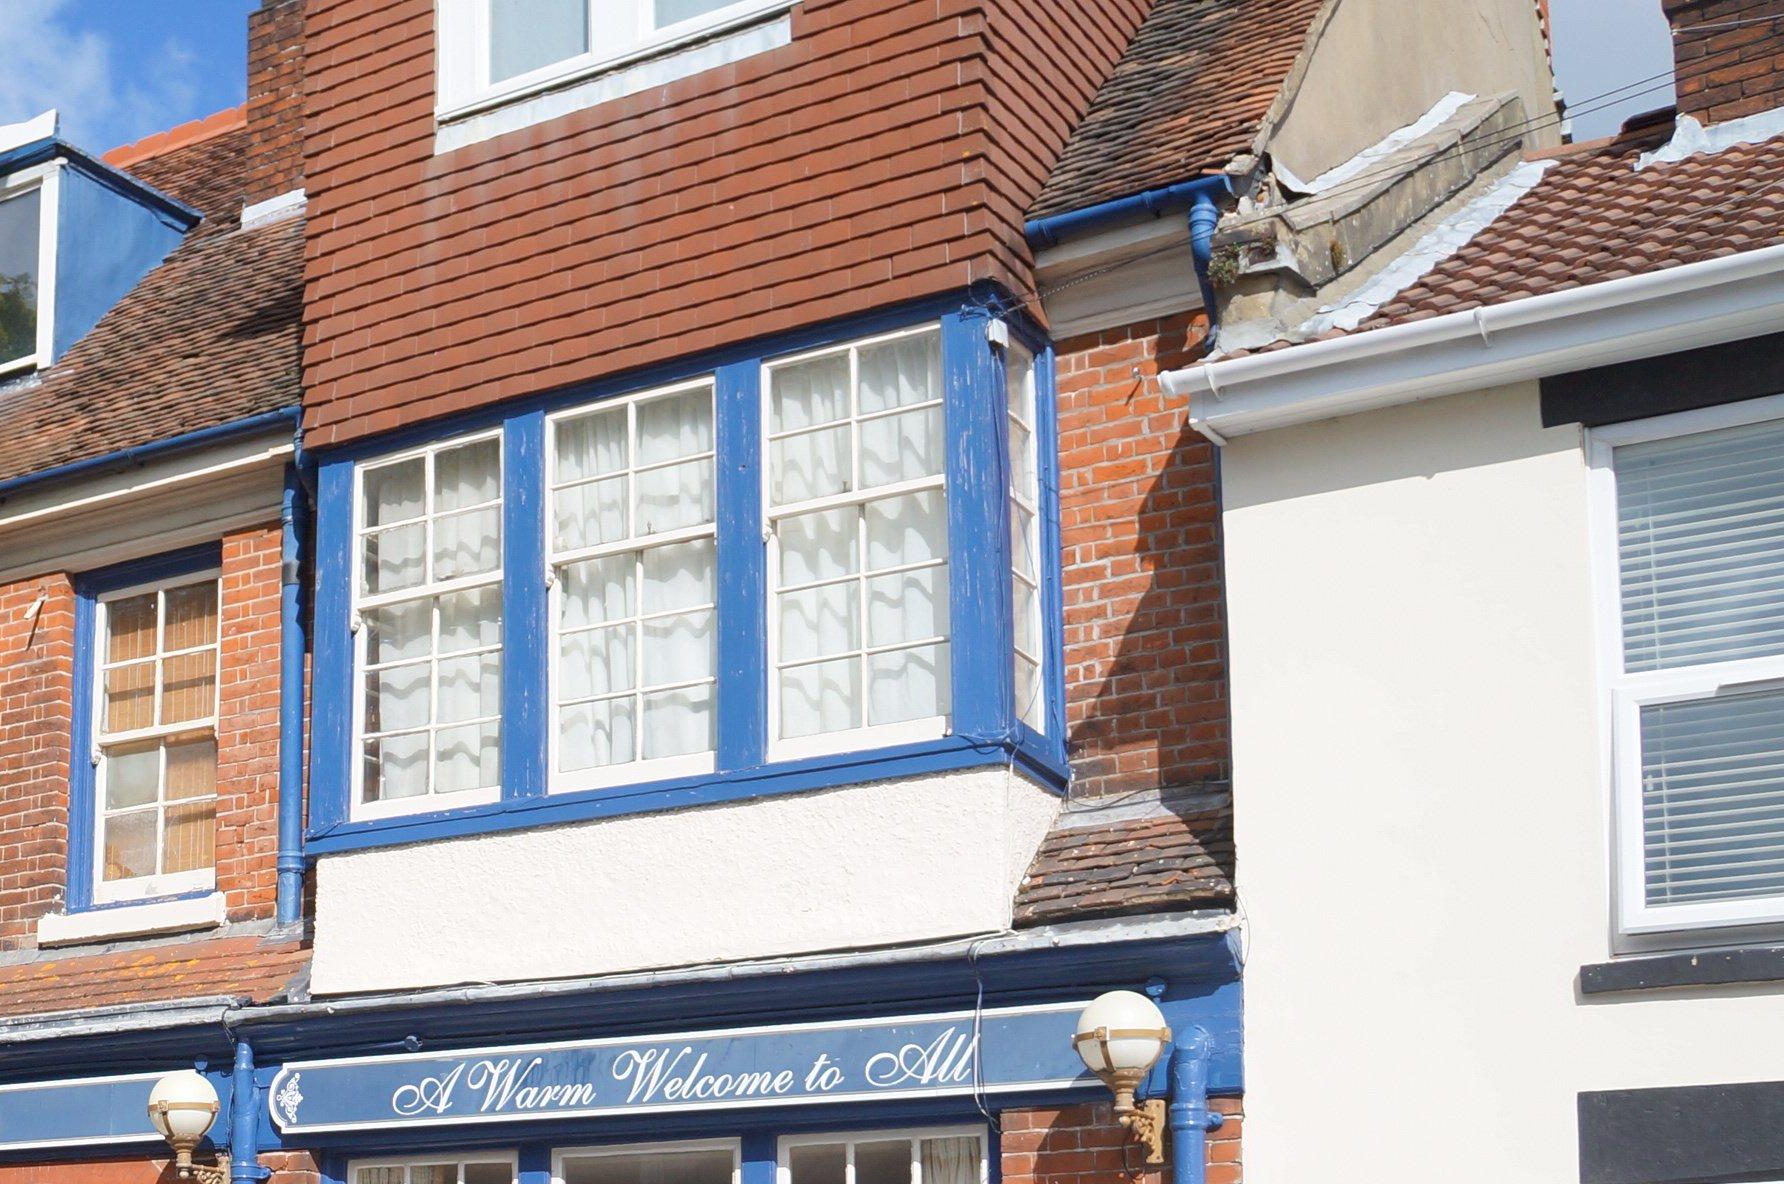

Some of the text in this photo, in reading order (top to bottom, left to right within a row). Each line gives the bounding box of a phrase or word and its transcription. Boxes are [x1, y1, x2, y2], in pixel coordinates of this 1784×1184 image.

[393, 1027, 980, 1115] A Warm Welcome to All
